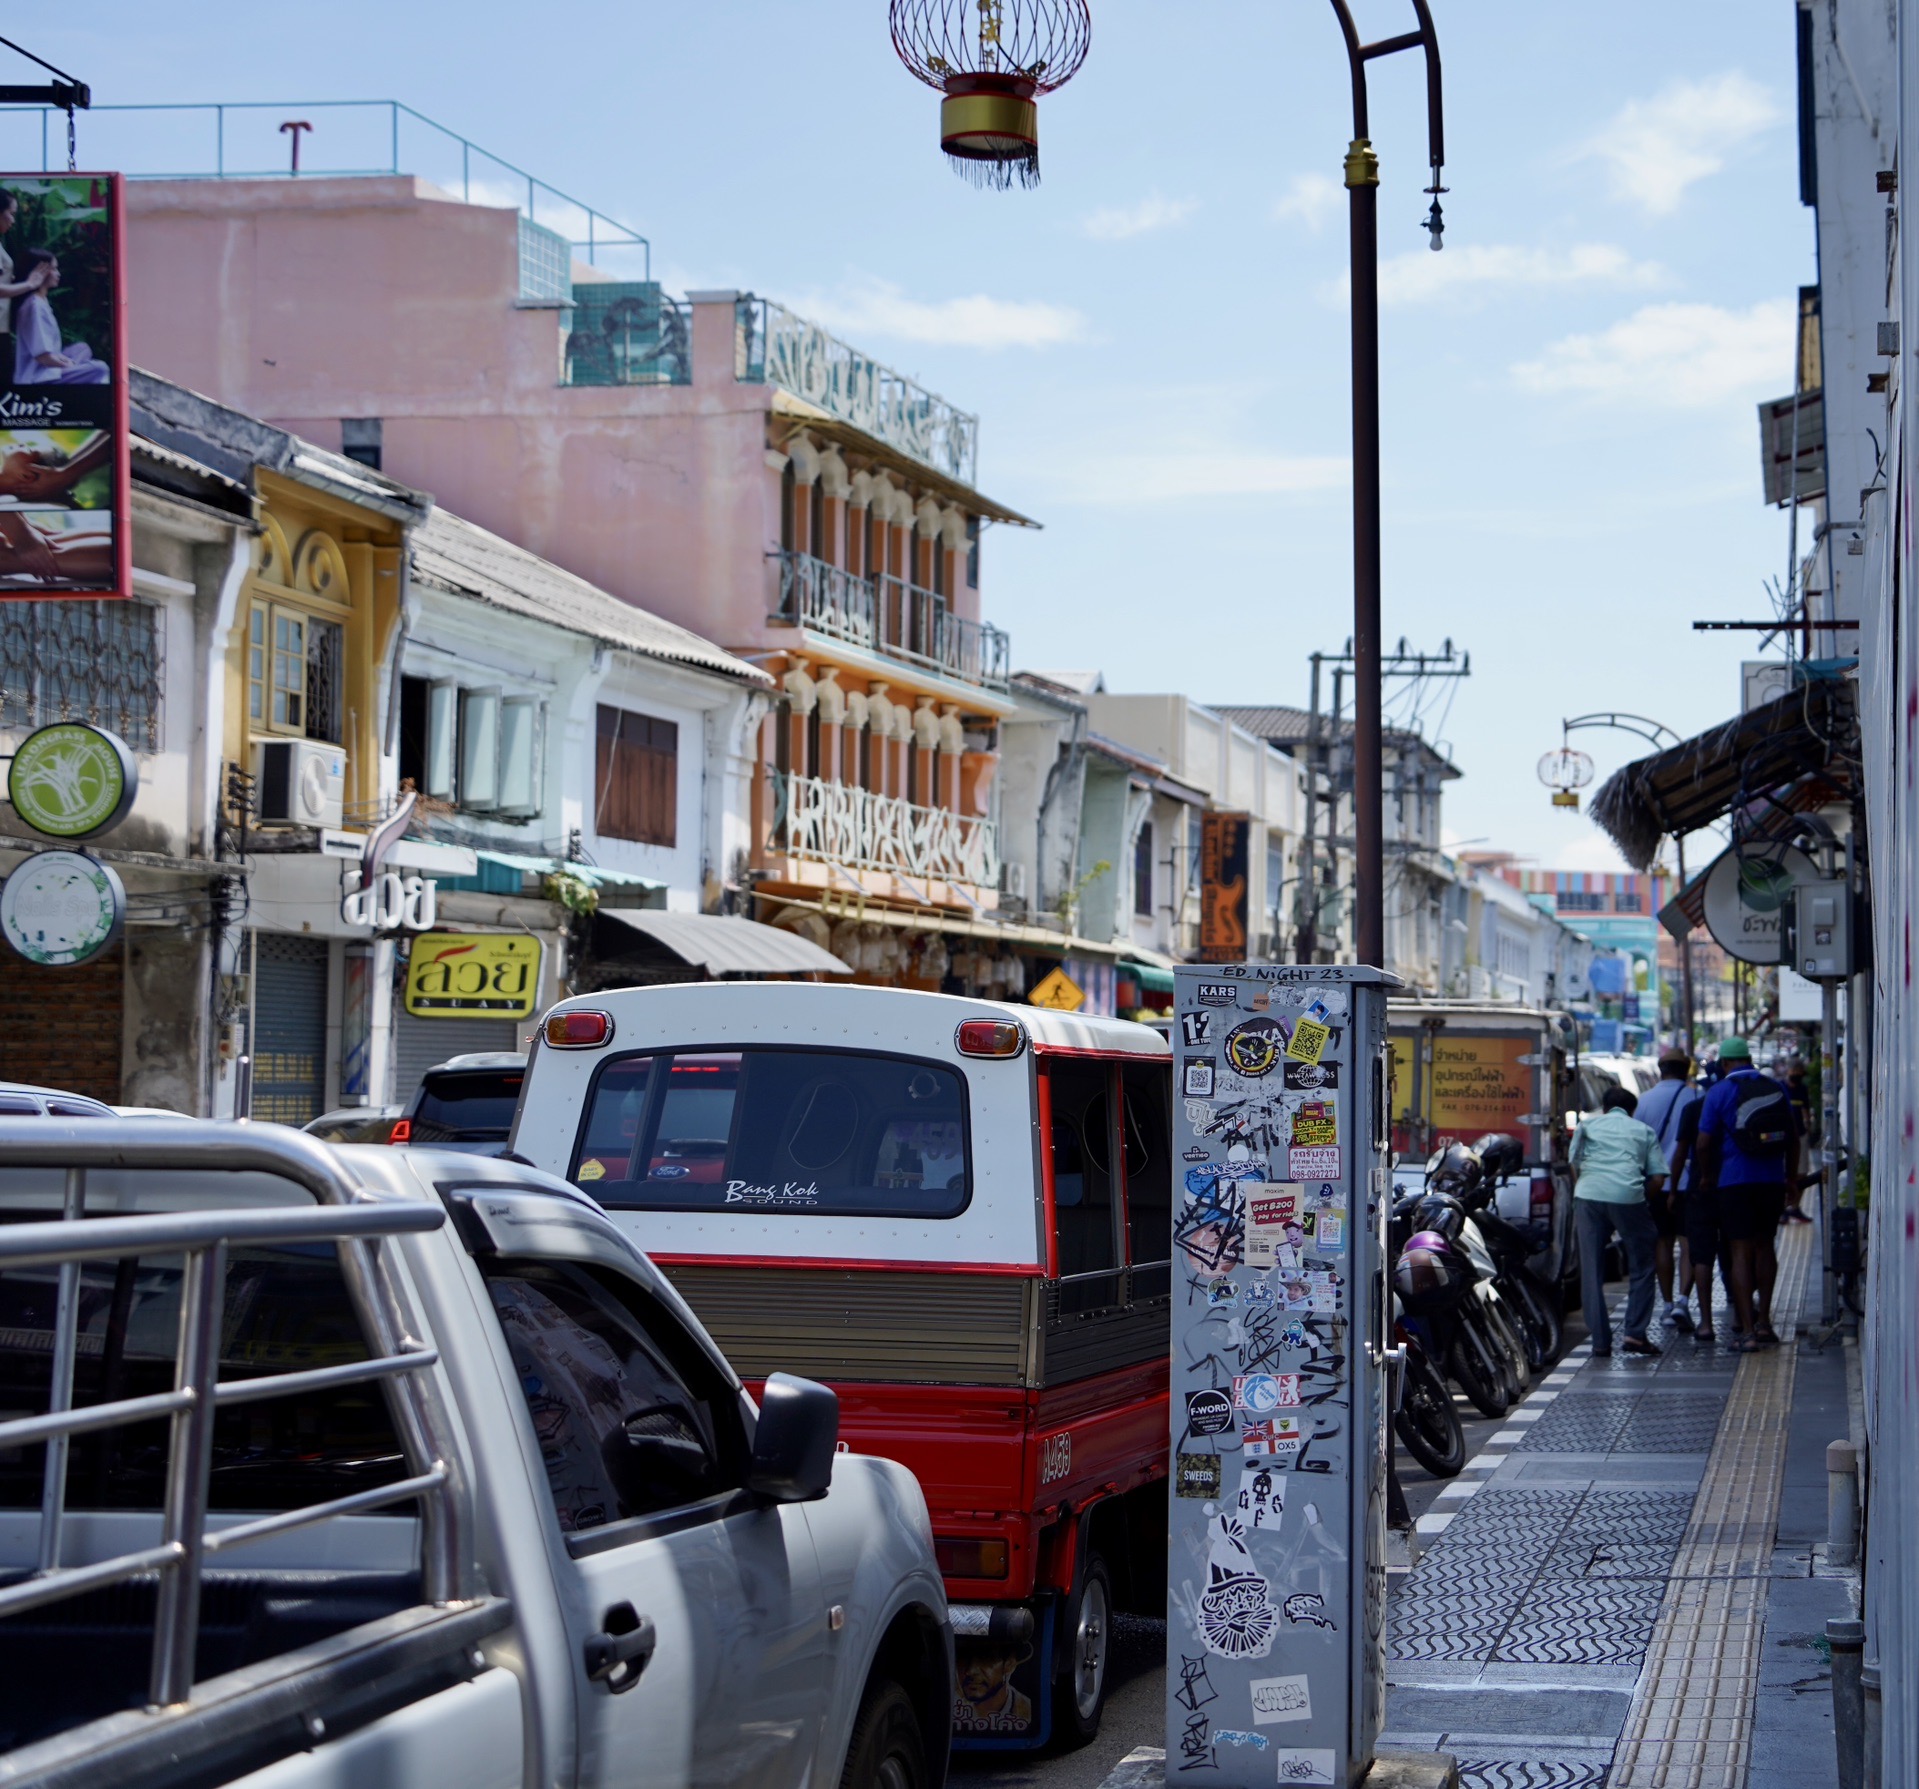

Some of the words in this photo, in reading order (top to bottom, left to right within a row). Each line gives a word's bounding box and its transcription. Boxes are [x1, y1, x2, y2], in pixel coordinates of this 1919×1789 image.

[1200, 986, 1236, 997] KARS
[1297, 1120, 1315, 1128] DUB
[1315, 1118, 1327, 1126] FX
[656, 1166, 680, 1176] Ford
[725, 1180, 776, 1203] Bang
[783, 1182, 820, 1197] Kok
[1252, 1202, 1269, 1212] Get
[1257, 1213, 1270, 1221] pay
[1190, 1403, 1228, 1416] F-WORD
[1277, 1441, 1296, 1450] OX5
[1042, 1431, 1071, 1484] A459
[1184, 1471, 1213, 1481] SWEEDS
